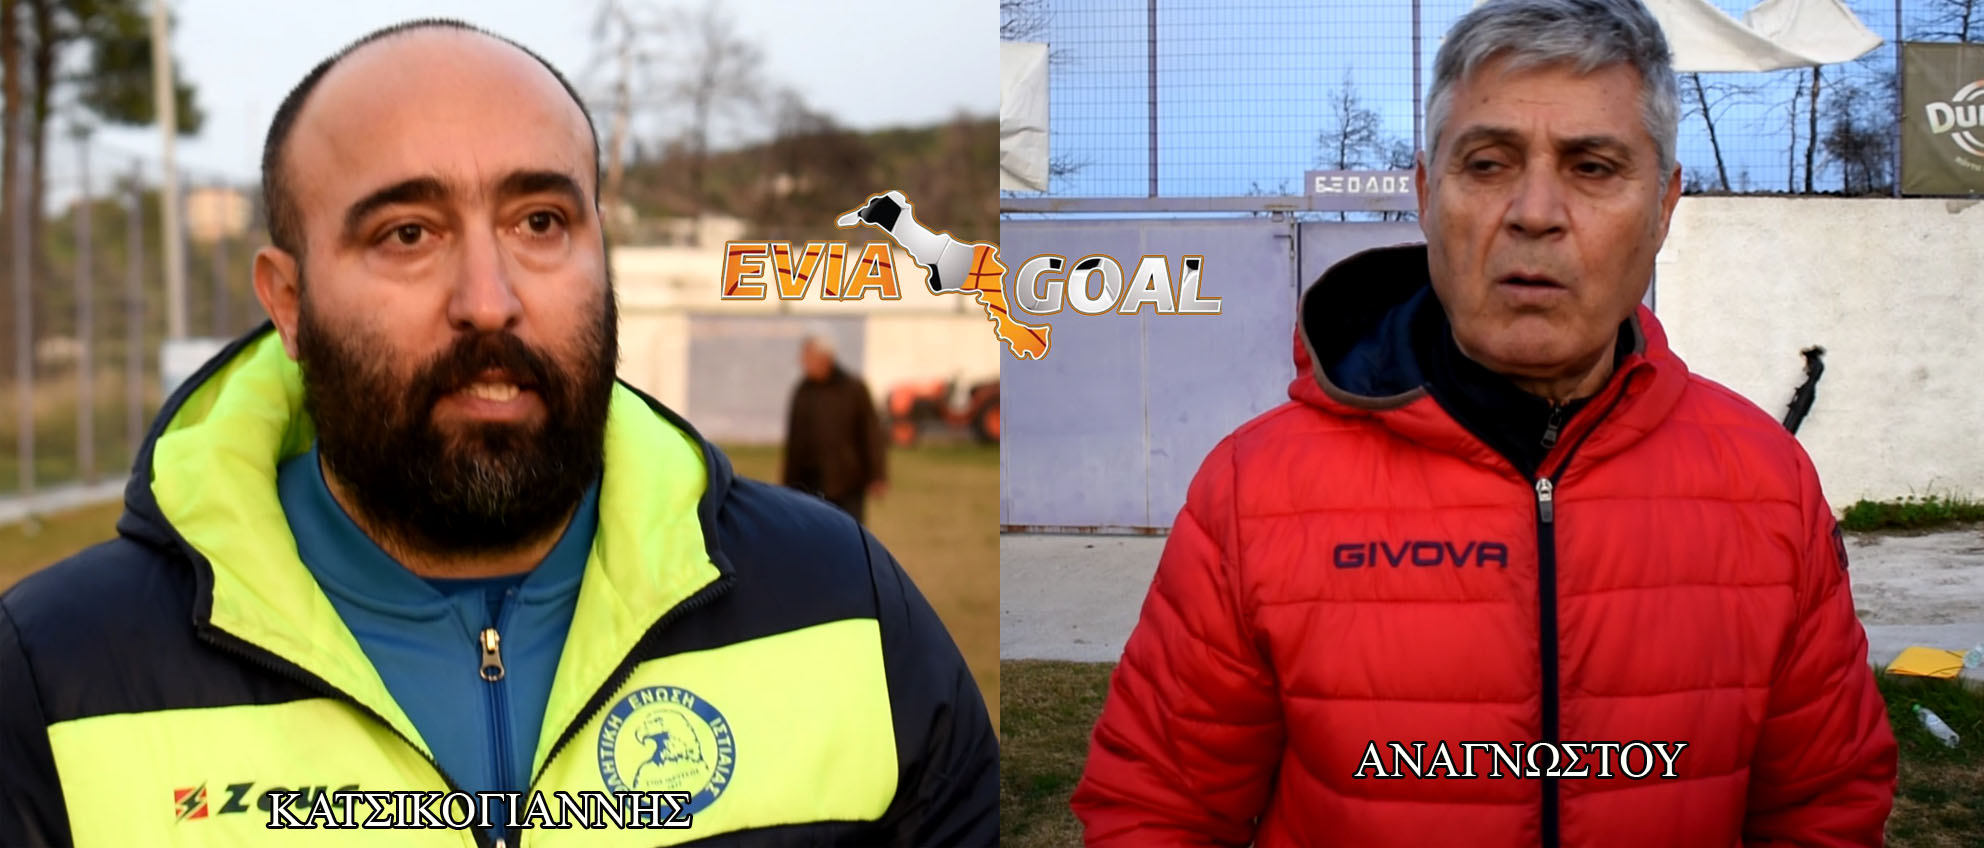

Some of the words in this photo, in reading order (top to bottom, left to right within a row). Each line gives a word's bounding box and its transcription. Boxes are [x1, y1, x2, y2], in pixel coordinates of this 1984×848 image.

[1315, 176, 1410, 193] ΕΞΟΔΟΣ
[1333, 541, 1509, 568] GIVOVA
[600, 714, 630, 792] ΛΗΤΙΚΗ
[628, 687, 695, 710] ΕΝΩΣΗ
[705, 716, 732, 797] ΙΣΤΙΑΙΑΣ
